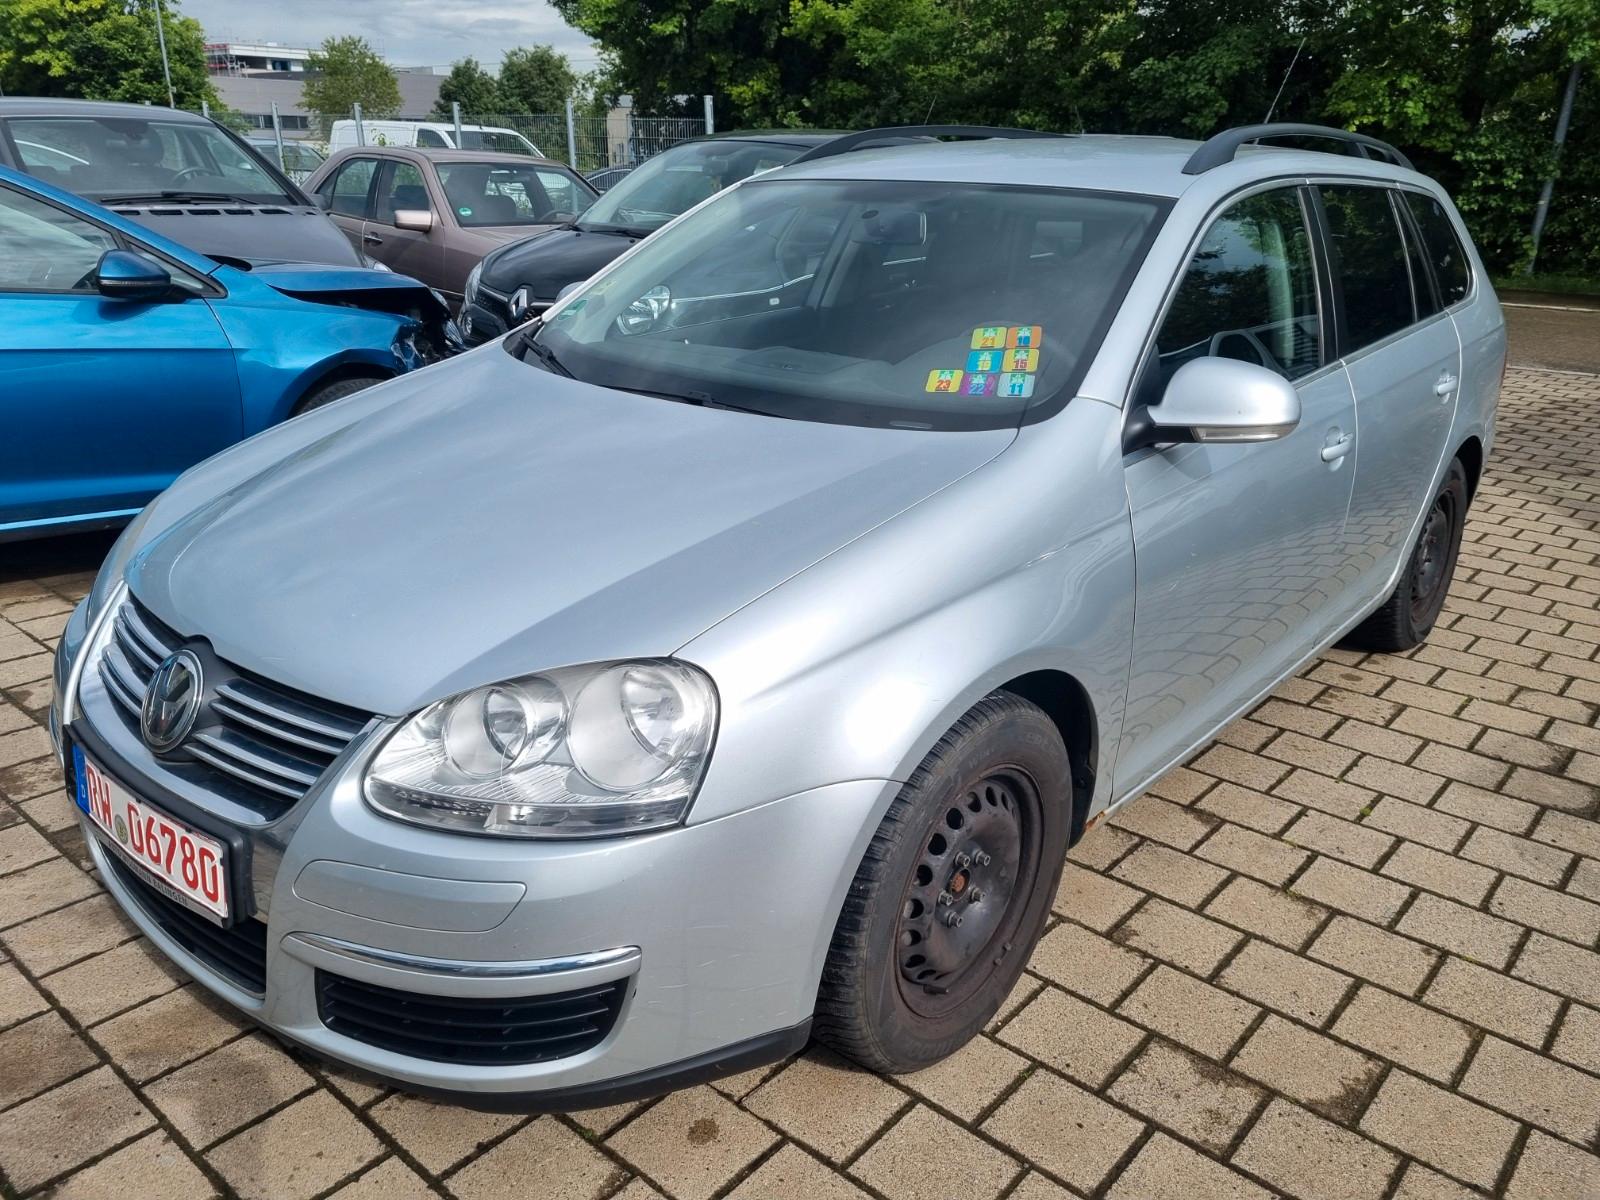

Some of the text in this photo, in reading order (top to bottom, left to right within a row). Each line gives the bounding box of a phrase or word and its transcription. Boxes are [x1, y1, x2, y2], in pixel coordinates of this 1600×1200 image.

[981, 336, 996, 347] 21
[1013, 359, 1029, 369] 15
[936, 379, 952, 390] 23
[968, 384, 985, 395] 22
[1009, 383, 1025, 394] 11
[86, 764, 113, 829] RW
[127, 802, 219, 903] 06780
